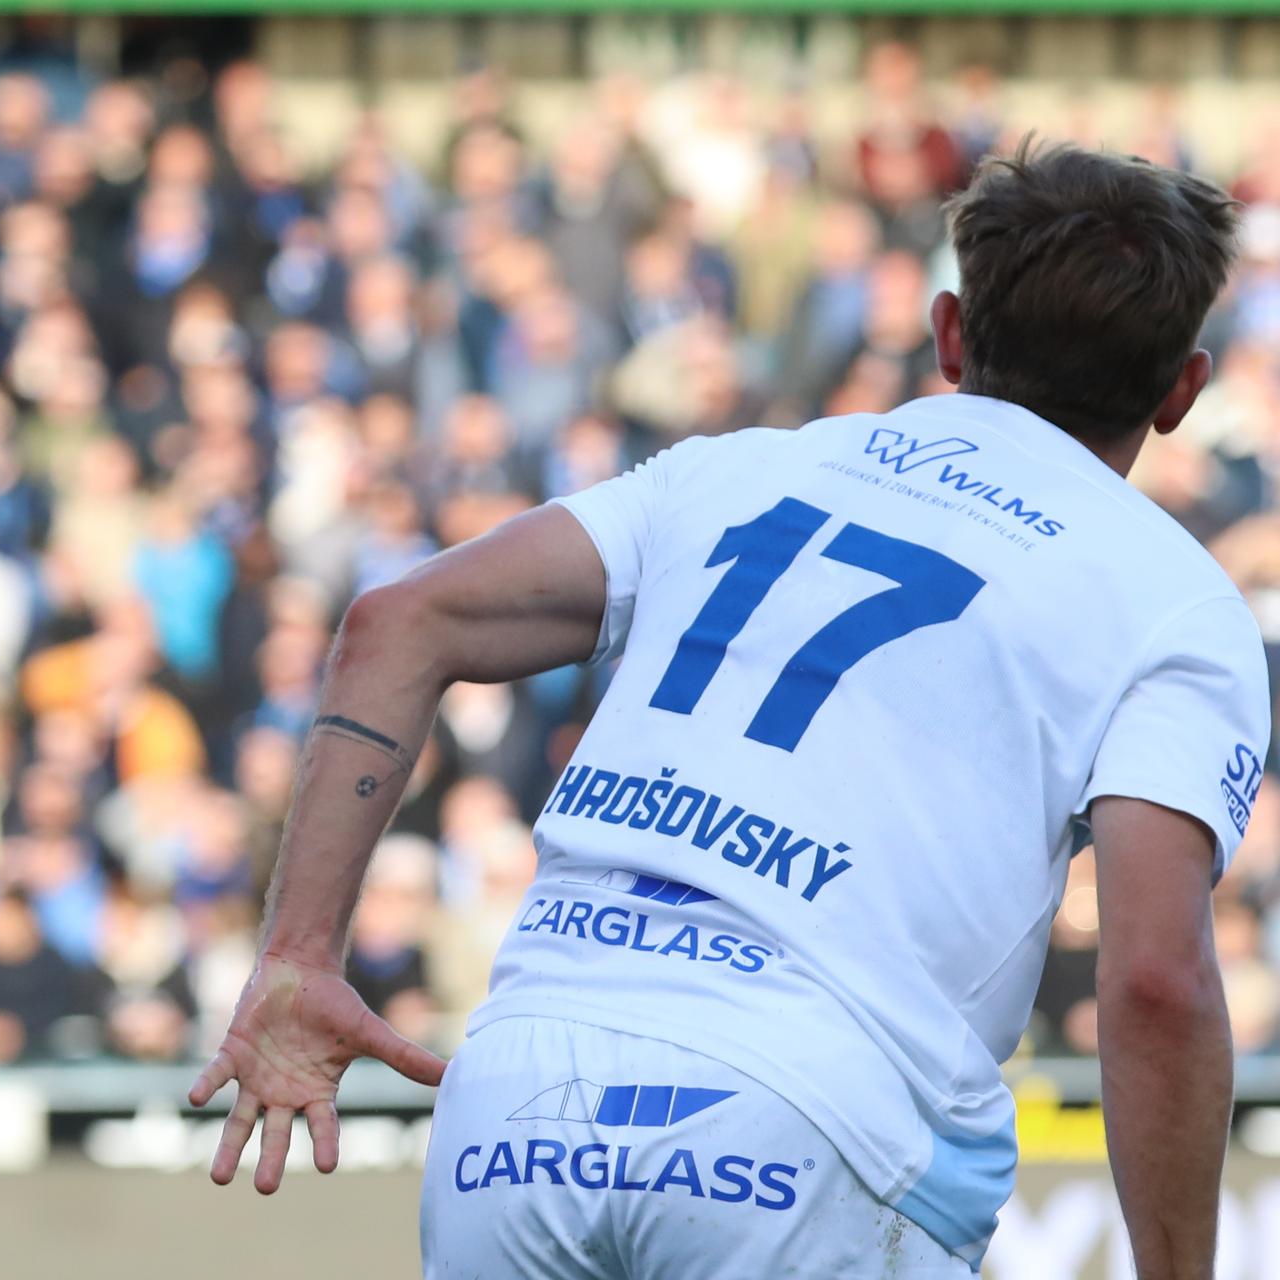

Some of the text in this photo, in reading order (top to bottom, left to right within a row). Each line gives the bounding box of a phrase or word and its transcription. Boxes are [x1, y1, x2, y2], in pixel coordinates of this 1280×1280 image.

[938, 464, 1065, 537] WILMS
[649, 496, 987, 753] 17
[545, 765, 853, 902] HROŠOVSKÝ
